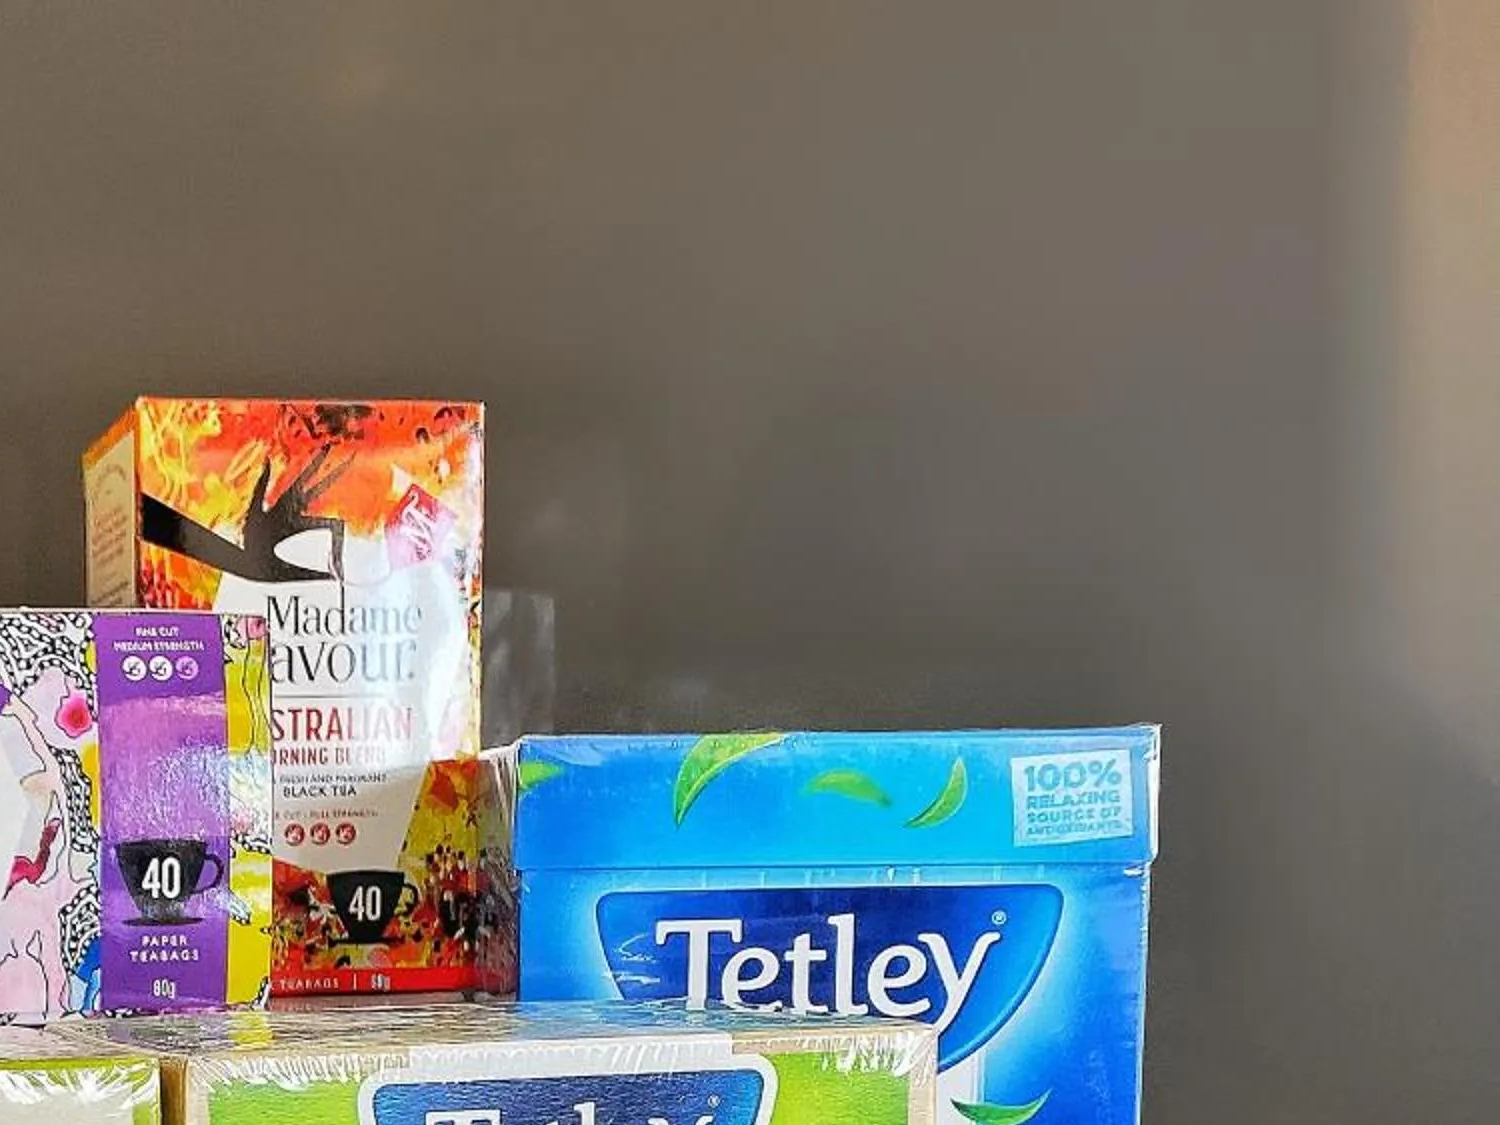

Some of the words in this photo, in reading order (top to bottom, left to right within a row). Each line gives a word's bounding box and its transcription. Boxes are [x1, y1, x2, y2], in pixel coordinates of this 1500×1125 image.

[267, 592, 423, 637] Madame
[159, 626, 180, 637] CUT
[270, 640, 417, 684] avour
[271, 706, 413, 742] STRALIAN
[270, 747, 329, 766] ORNING
[1024, 758, 1122, 792] 100%
[283, 785, 327, 798] BLACK
[331, 785, 357, 797] TEA
[1027, 789, 1121, 809] RELAXING
[1027, 807, 1095, 823] SOURCE
[141, 856, 181, 899] 40
[348, 885, 382, 922] 40
[141, 935, 188, 947] PAPER
[129, 949, 200, 963] TEABAGS
[655, 912, 1002, 1029] Tetley
[153, 978, 177, 999] 80g
